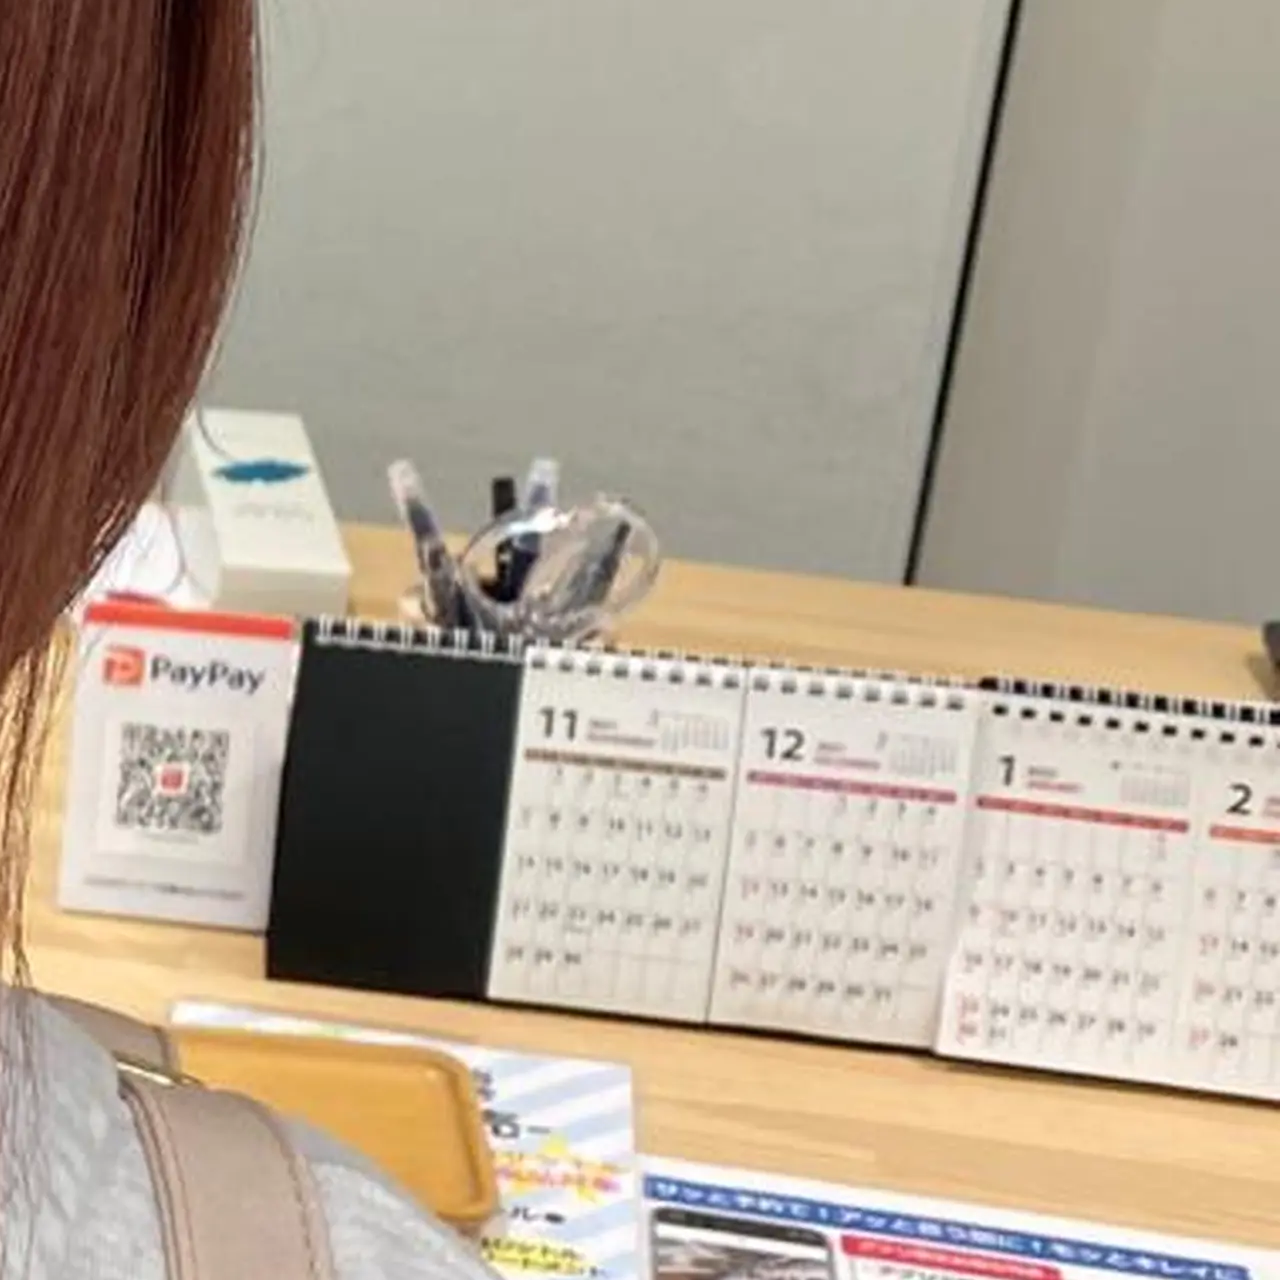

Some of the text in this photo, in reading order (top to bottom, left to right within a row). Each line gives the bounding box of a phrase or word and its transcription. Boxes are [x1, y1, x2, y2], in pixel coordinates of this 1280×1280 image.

[151, 654, 266, 696] PayPay
[538, 706, 579, 741] 11
[760, 726, 806, 761] 12
[997, 755, 1016, 787] 1
[1226, 782, 1252, 816] 2
